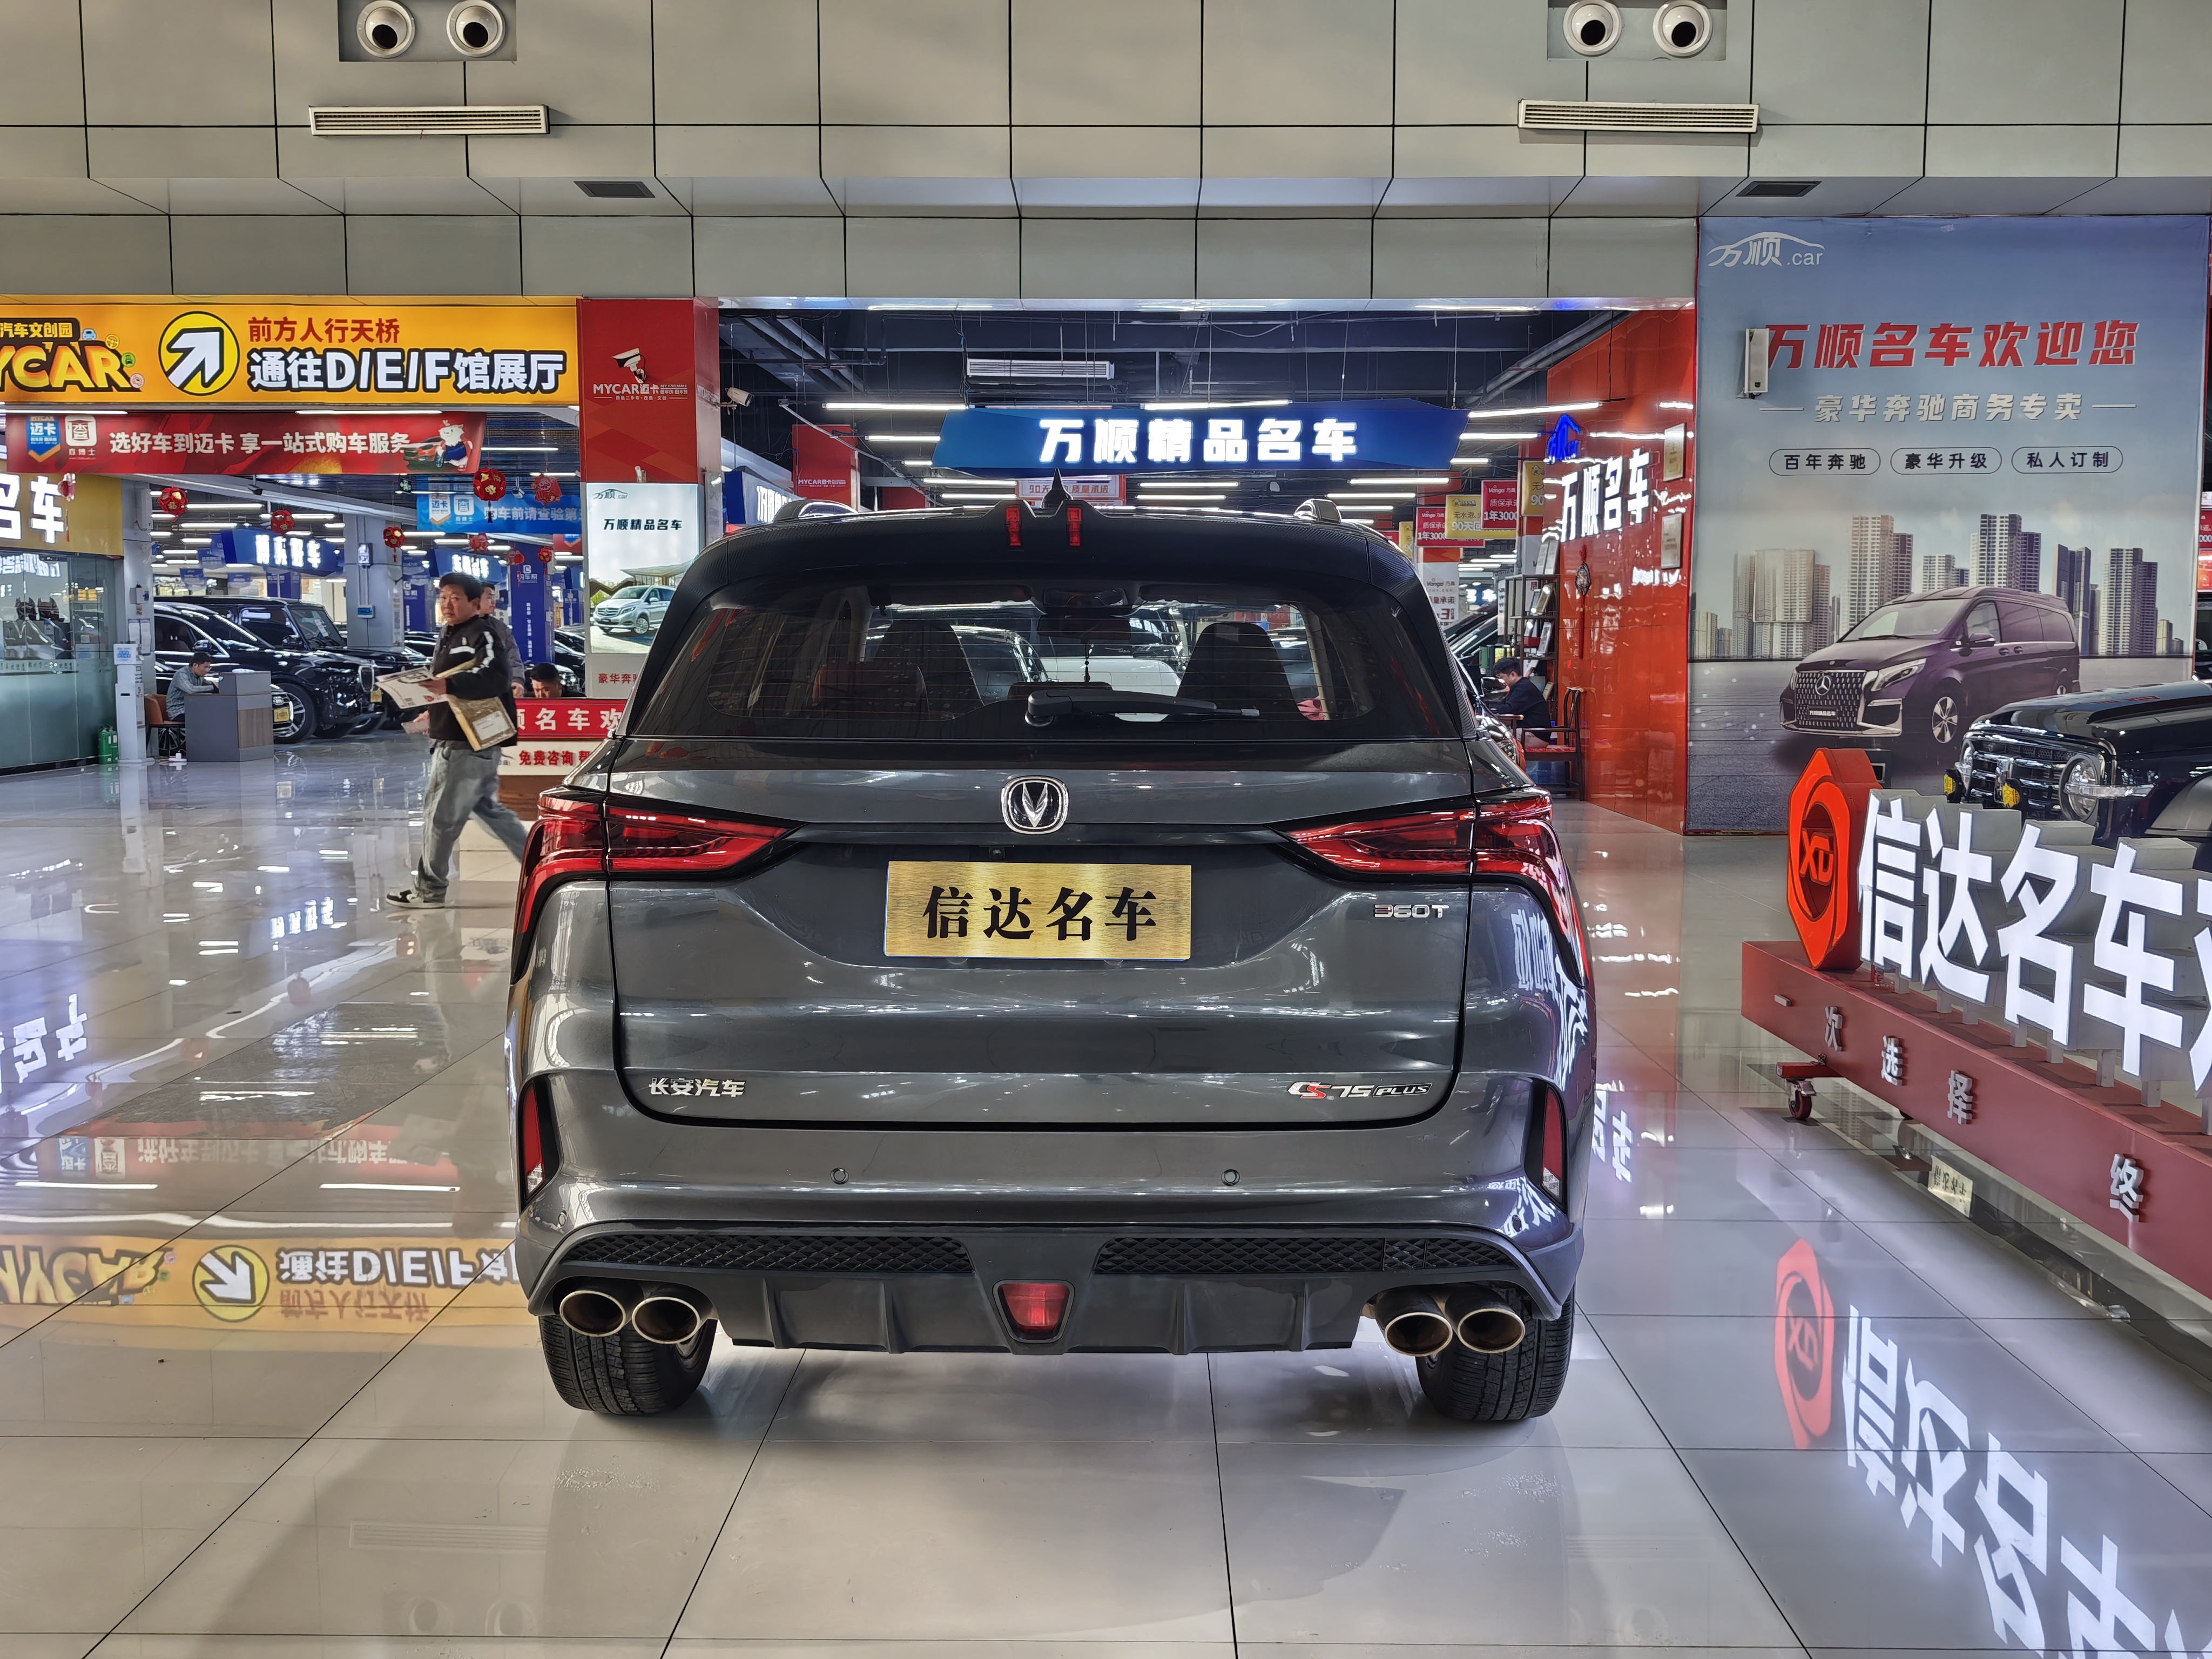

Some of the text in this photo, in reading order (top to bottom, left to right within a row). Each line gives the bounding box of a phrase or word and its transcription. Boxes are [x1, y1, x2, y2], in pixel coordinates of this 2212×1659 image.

[248, 317, 400, 343] 前方人行天桥
[1766, 321, 2140, 369] 万顺名车欢迎您
[251, 351, 563, 390] 通往D/E/F馆展厅
[1815, 394, 2082, 423] 豪华奔驰商务专卖
[109, 432, 410, 455] 选好车到迈卡 享一站式购车服务
[1040, 419, 1357, 462] 万顺精品名车
[1784, 454, 1866, 471] 百年奔驰
[1905, 453, 1988, 469] 豪华升级
[2026, 452, 2109, 469] 私人订制
[1561, 448, 1649, 542] 万顺名车
[484, 507, 581, 521] 购车前请查验第
[604, 519, 683, 530] 万顺精品名车
[519, 750, 574, 766] 免费咨询
[922, 886, 1157, 941] 信达名车
[1373, 903, 1451, 920] 360T
[1858, 790, 2212, 1092] 信达名车
[649, 1077, 746, 1097] 长安汽车
[1375, 1085, 1430, 1095] PLUS
